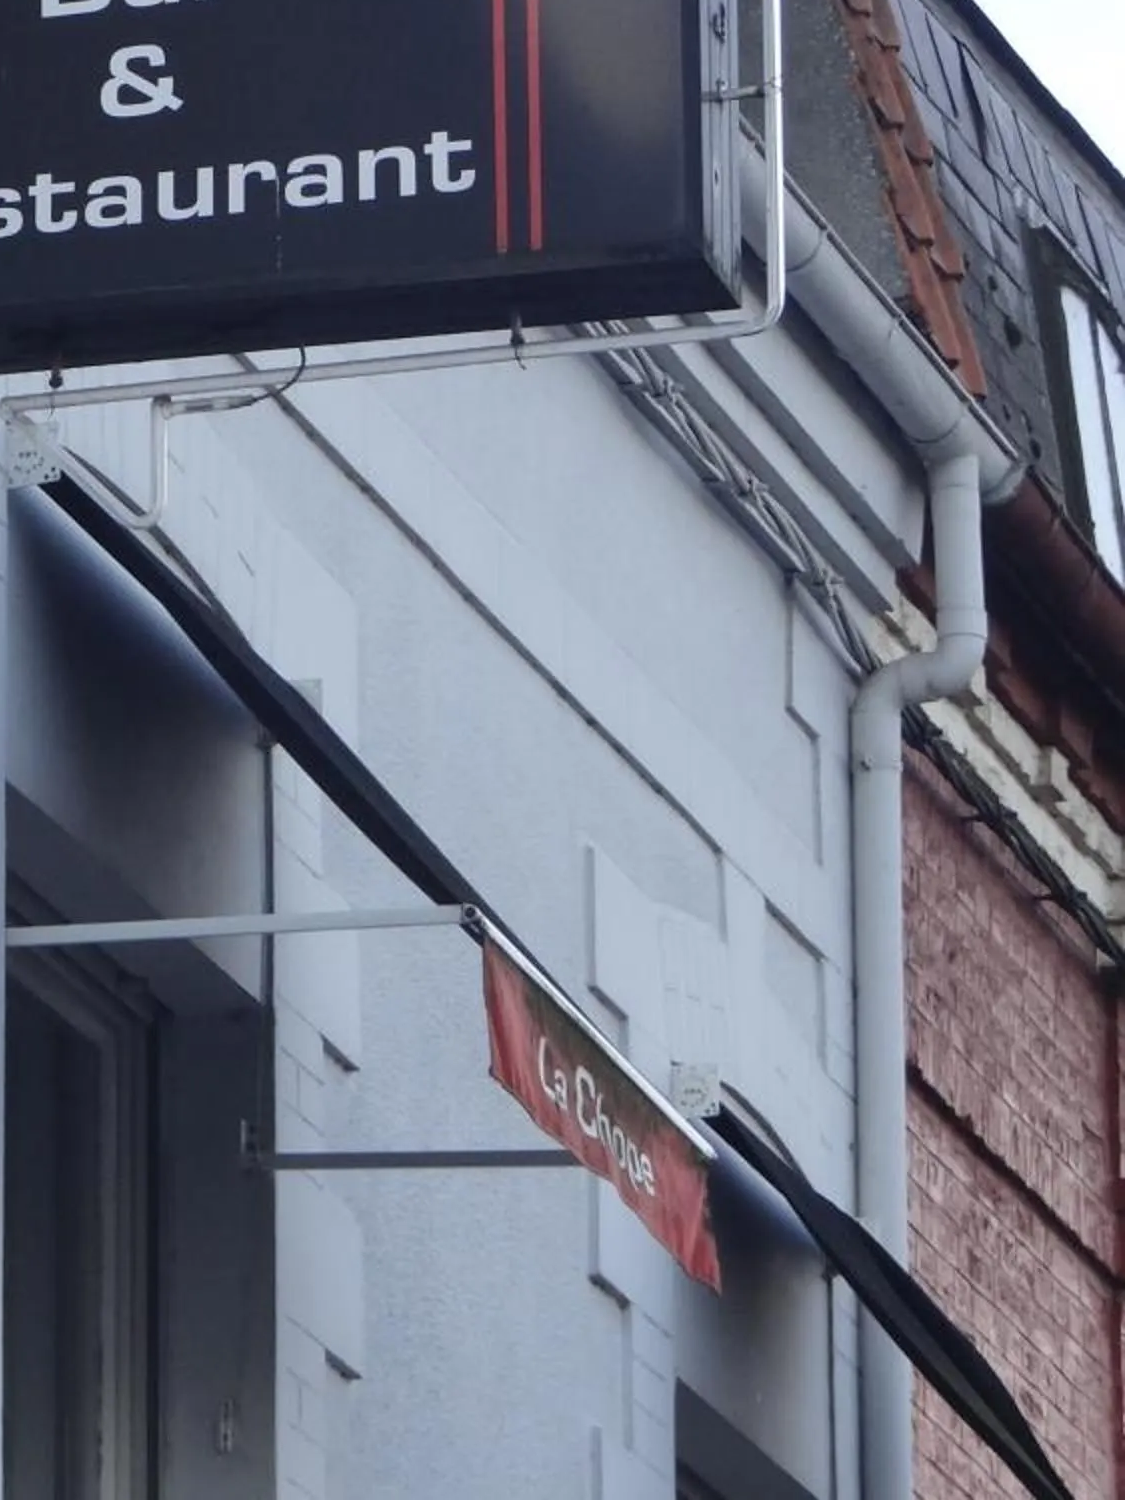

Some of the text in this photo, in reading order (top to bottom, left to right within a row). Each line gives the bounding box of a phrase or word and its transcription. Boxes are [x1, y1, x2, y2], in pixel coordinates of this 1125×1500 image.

[98, 44, 185, 118] &
[537, 1035, 656, 1197] La Chope
